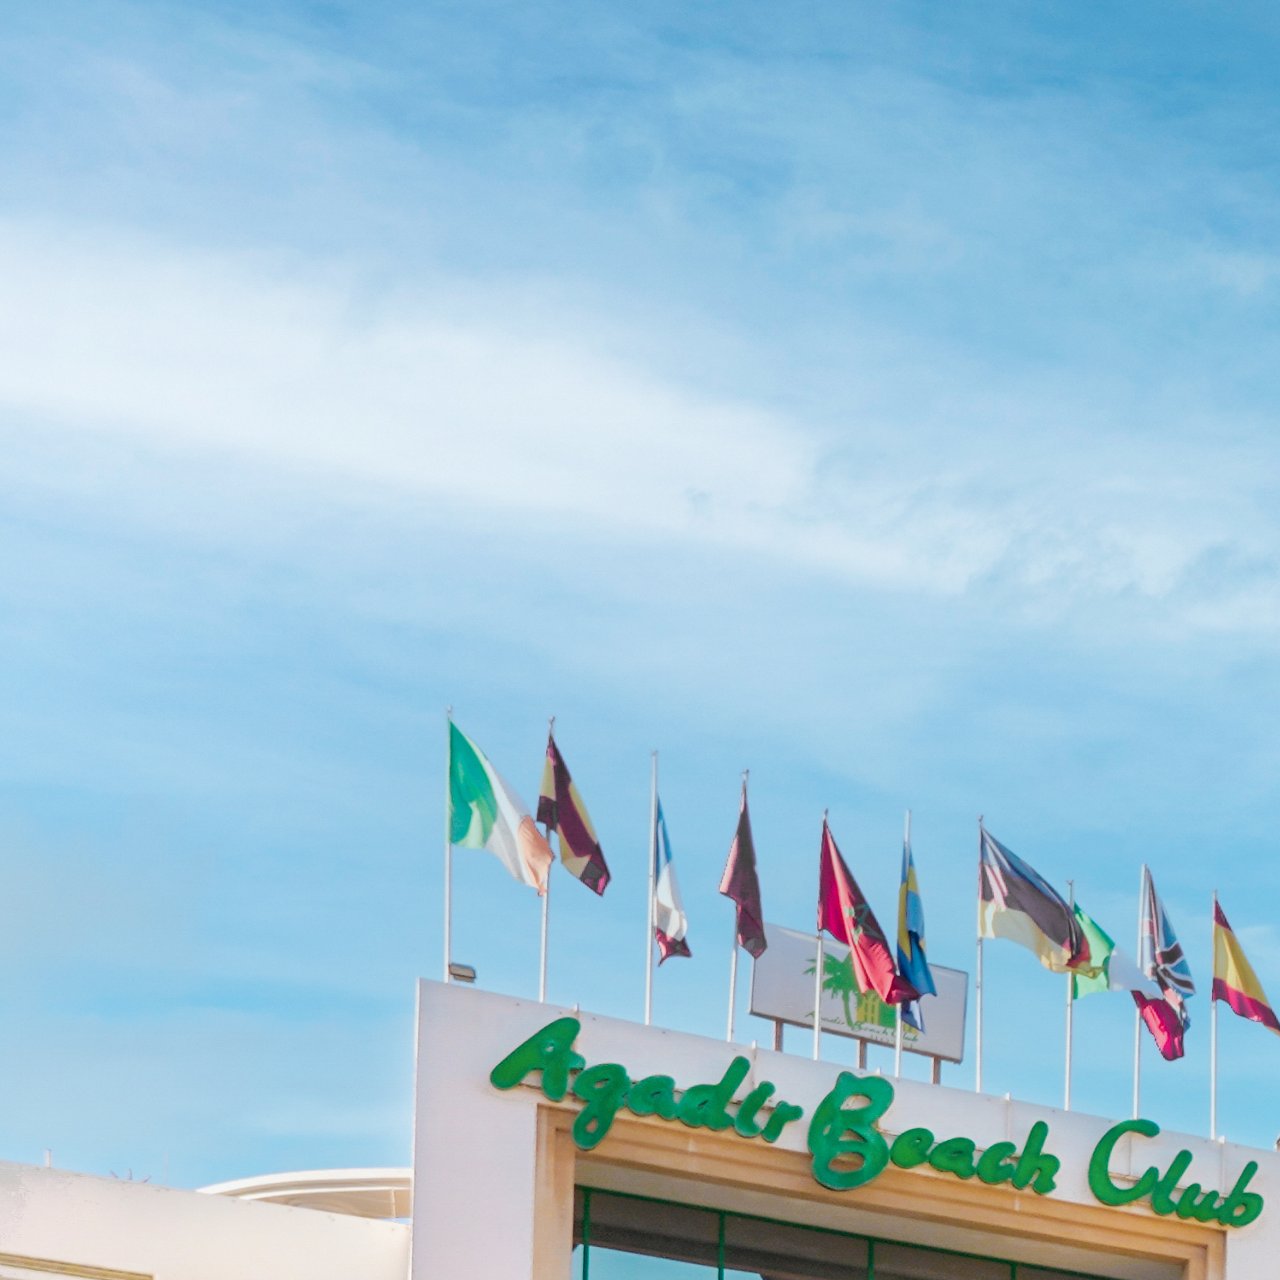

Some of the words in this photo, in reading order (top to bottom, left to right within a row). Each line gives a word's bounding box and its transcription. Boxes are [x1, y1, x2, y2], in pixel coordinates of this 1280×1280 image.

[490, 1016, 803, 1151] Agadir
[807, 1071, 1061, 1191] Beach
[1088, 1118, 1265, 1228] Club
